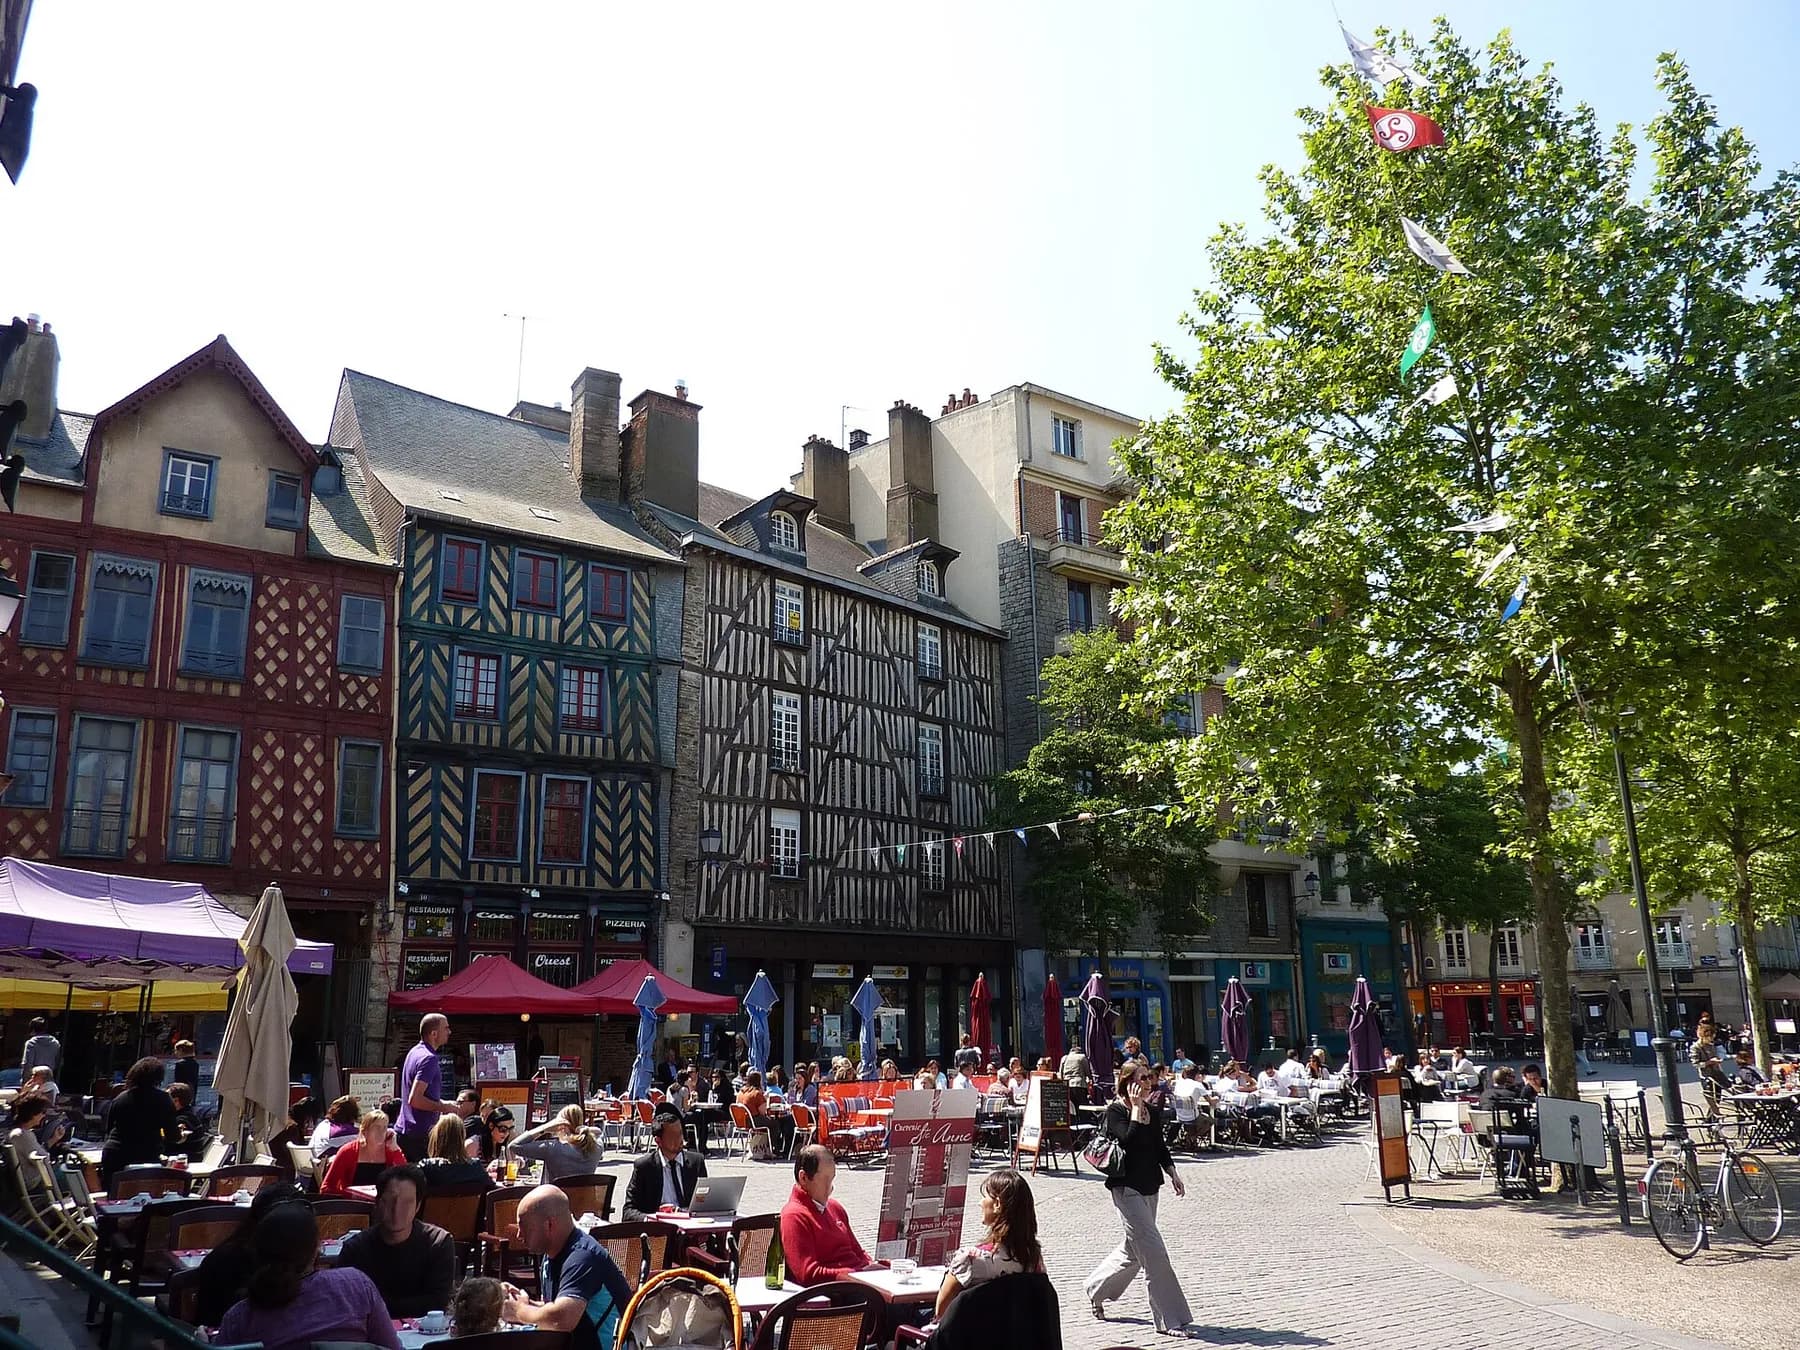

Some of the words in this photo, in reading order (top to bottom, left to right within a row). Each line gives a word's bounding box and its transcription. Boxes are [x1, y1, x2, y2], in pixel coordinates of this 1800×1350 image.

[409, 906, 456, 914] RESTAURANT
[532, 911, 581, 920] Ouest
[605, 919, 646, 928] PIZZERIA
[407, 955, 449, 963] RESTAURANT
[534, 954, 572, 968] Ouest
[932, 1122, 972, 1143] Anne
